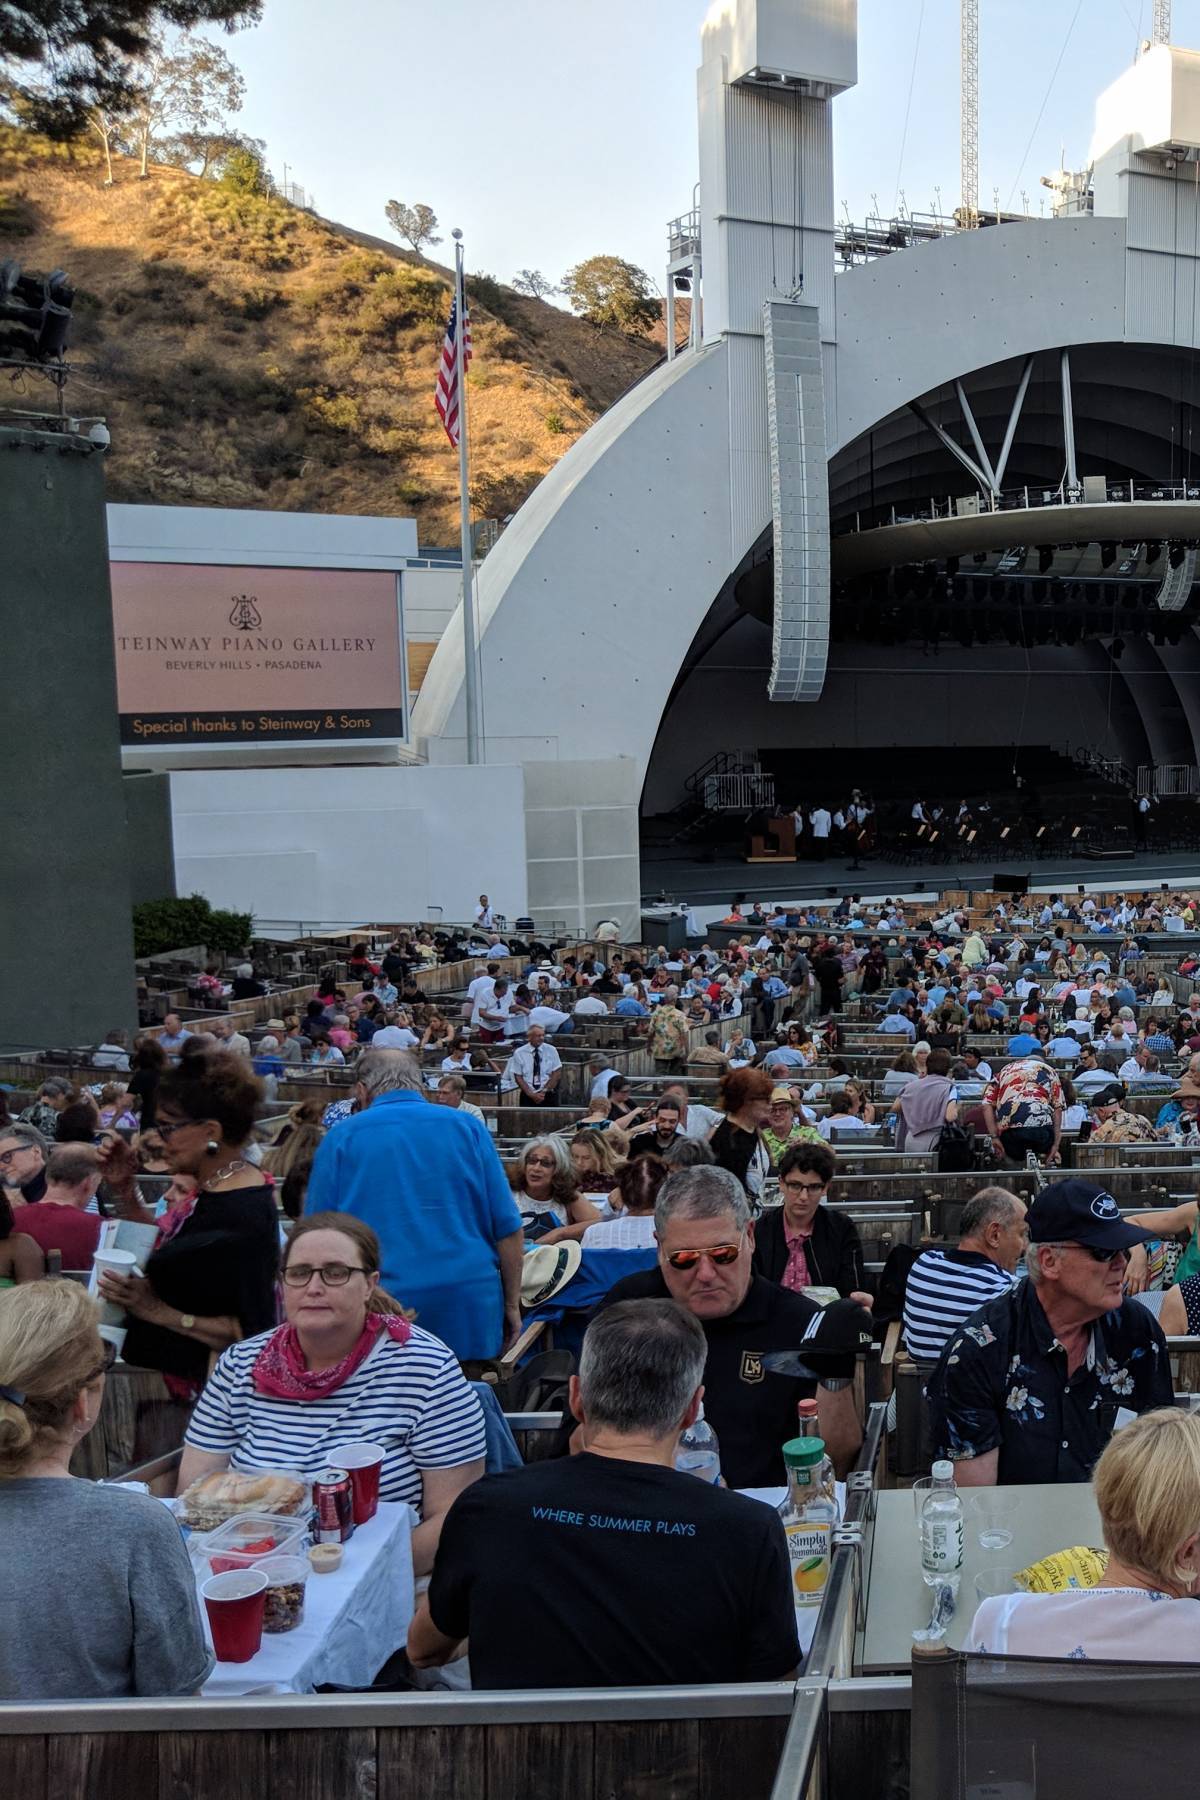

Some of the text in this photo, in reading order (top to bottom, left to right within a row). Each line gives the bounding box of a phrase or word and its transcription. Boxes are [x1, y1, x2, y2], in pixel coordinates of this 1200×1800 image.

[118, 636, 377, 652] TEINWAY PIANO GALLERY
[165, 660, 322, 670] BEVERLY HILLS PASADENA
[133, 715, 371, 736] Special thanks to Steinway & Sons
[532, 1506, 696, 1537] WHERE SUMMER PLAYS
[789, 1532, 826, 1549] Simply
[791, 1545, 828, 1560] Lemonade
[1079, 1559, 1094, 1586] CHIPS
